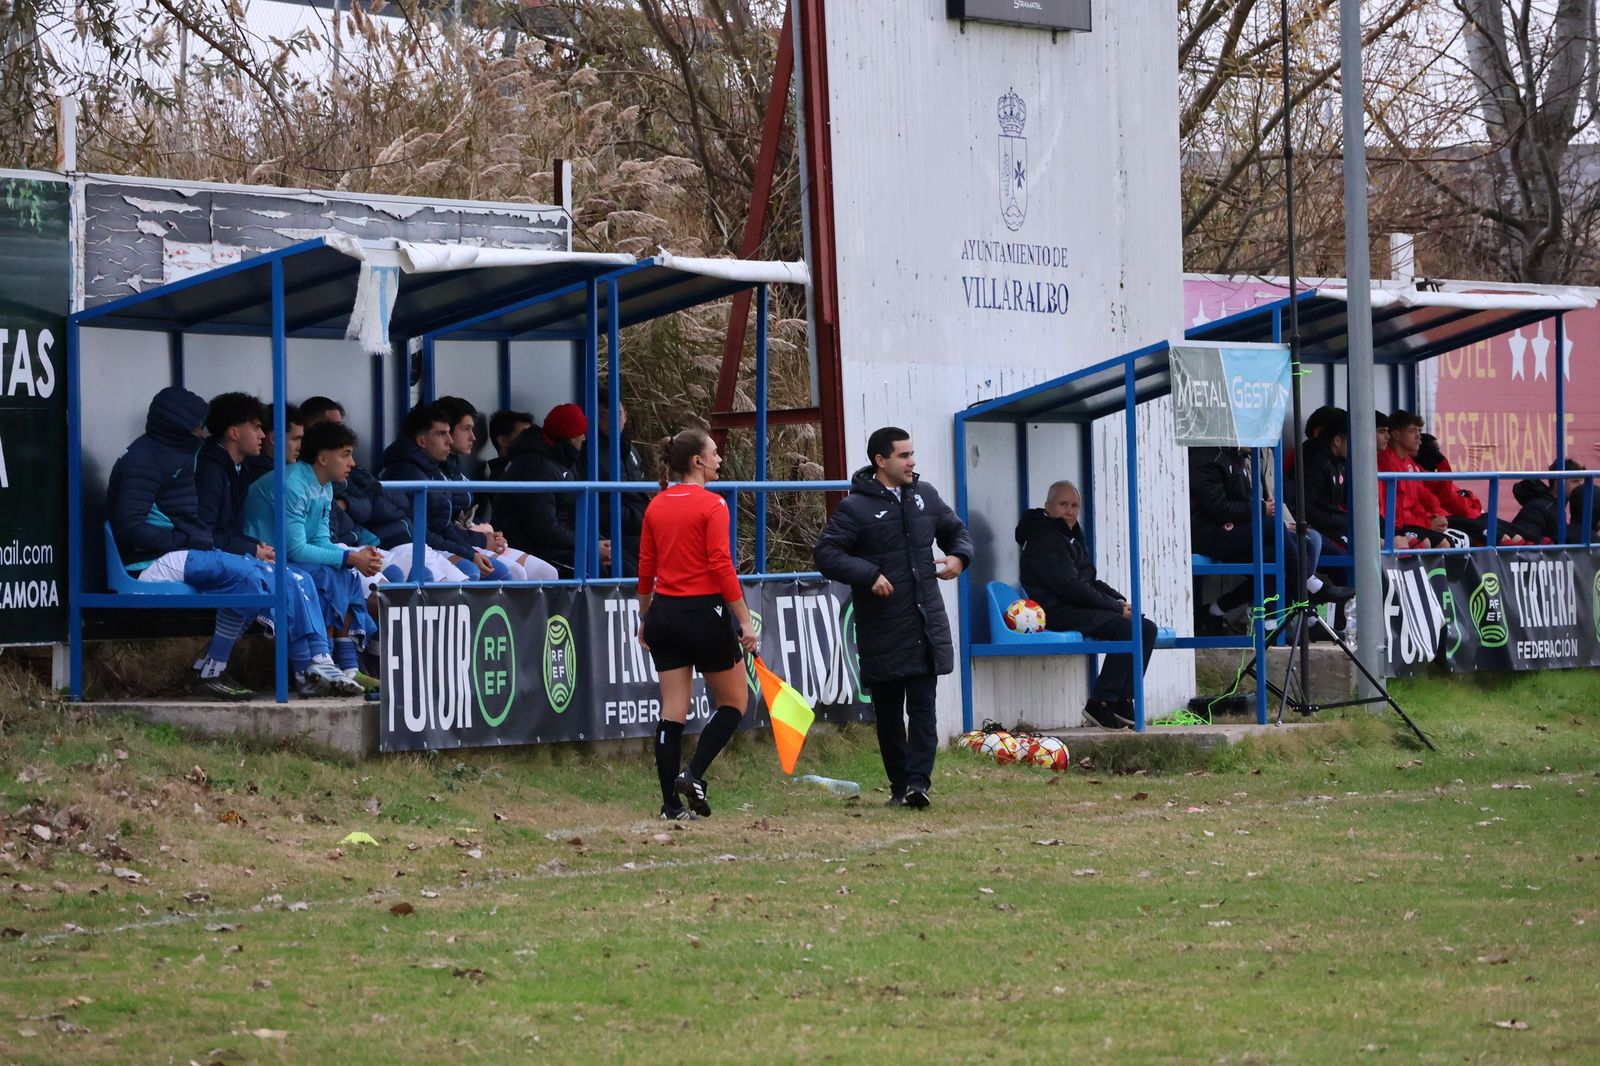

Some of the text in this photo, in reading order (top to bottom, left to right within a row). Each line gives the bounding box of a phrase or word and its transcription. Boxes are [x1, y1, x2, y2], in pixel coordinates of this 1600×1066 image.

[961, 240, 1068, 268] AYUNTAMIENTO DE
[962, 276, 1069, 315] VILLARALBO
[0, 580, 60, 609] AMORA
[1510, 560, 1577, 628] TERCERA
[1517, 632, 1578, 660] FEDERACIÓN
